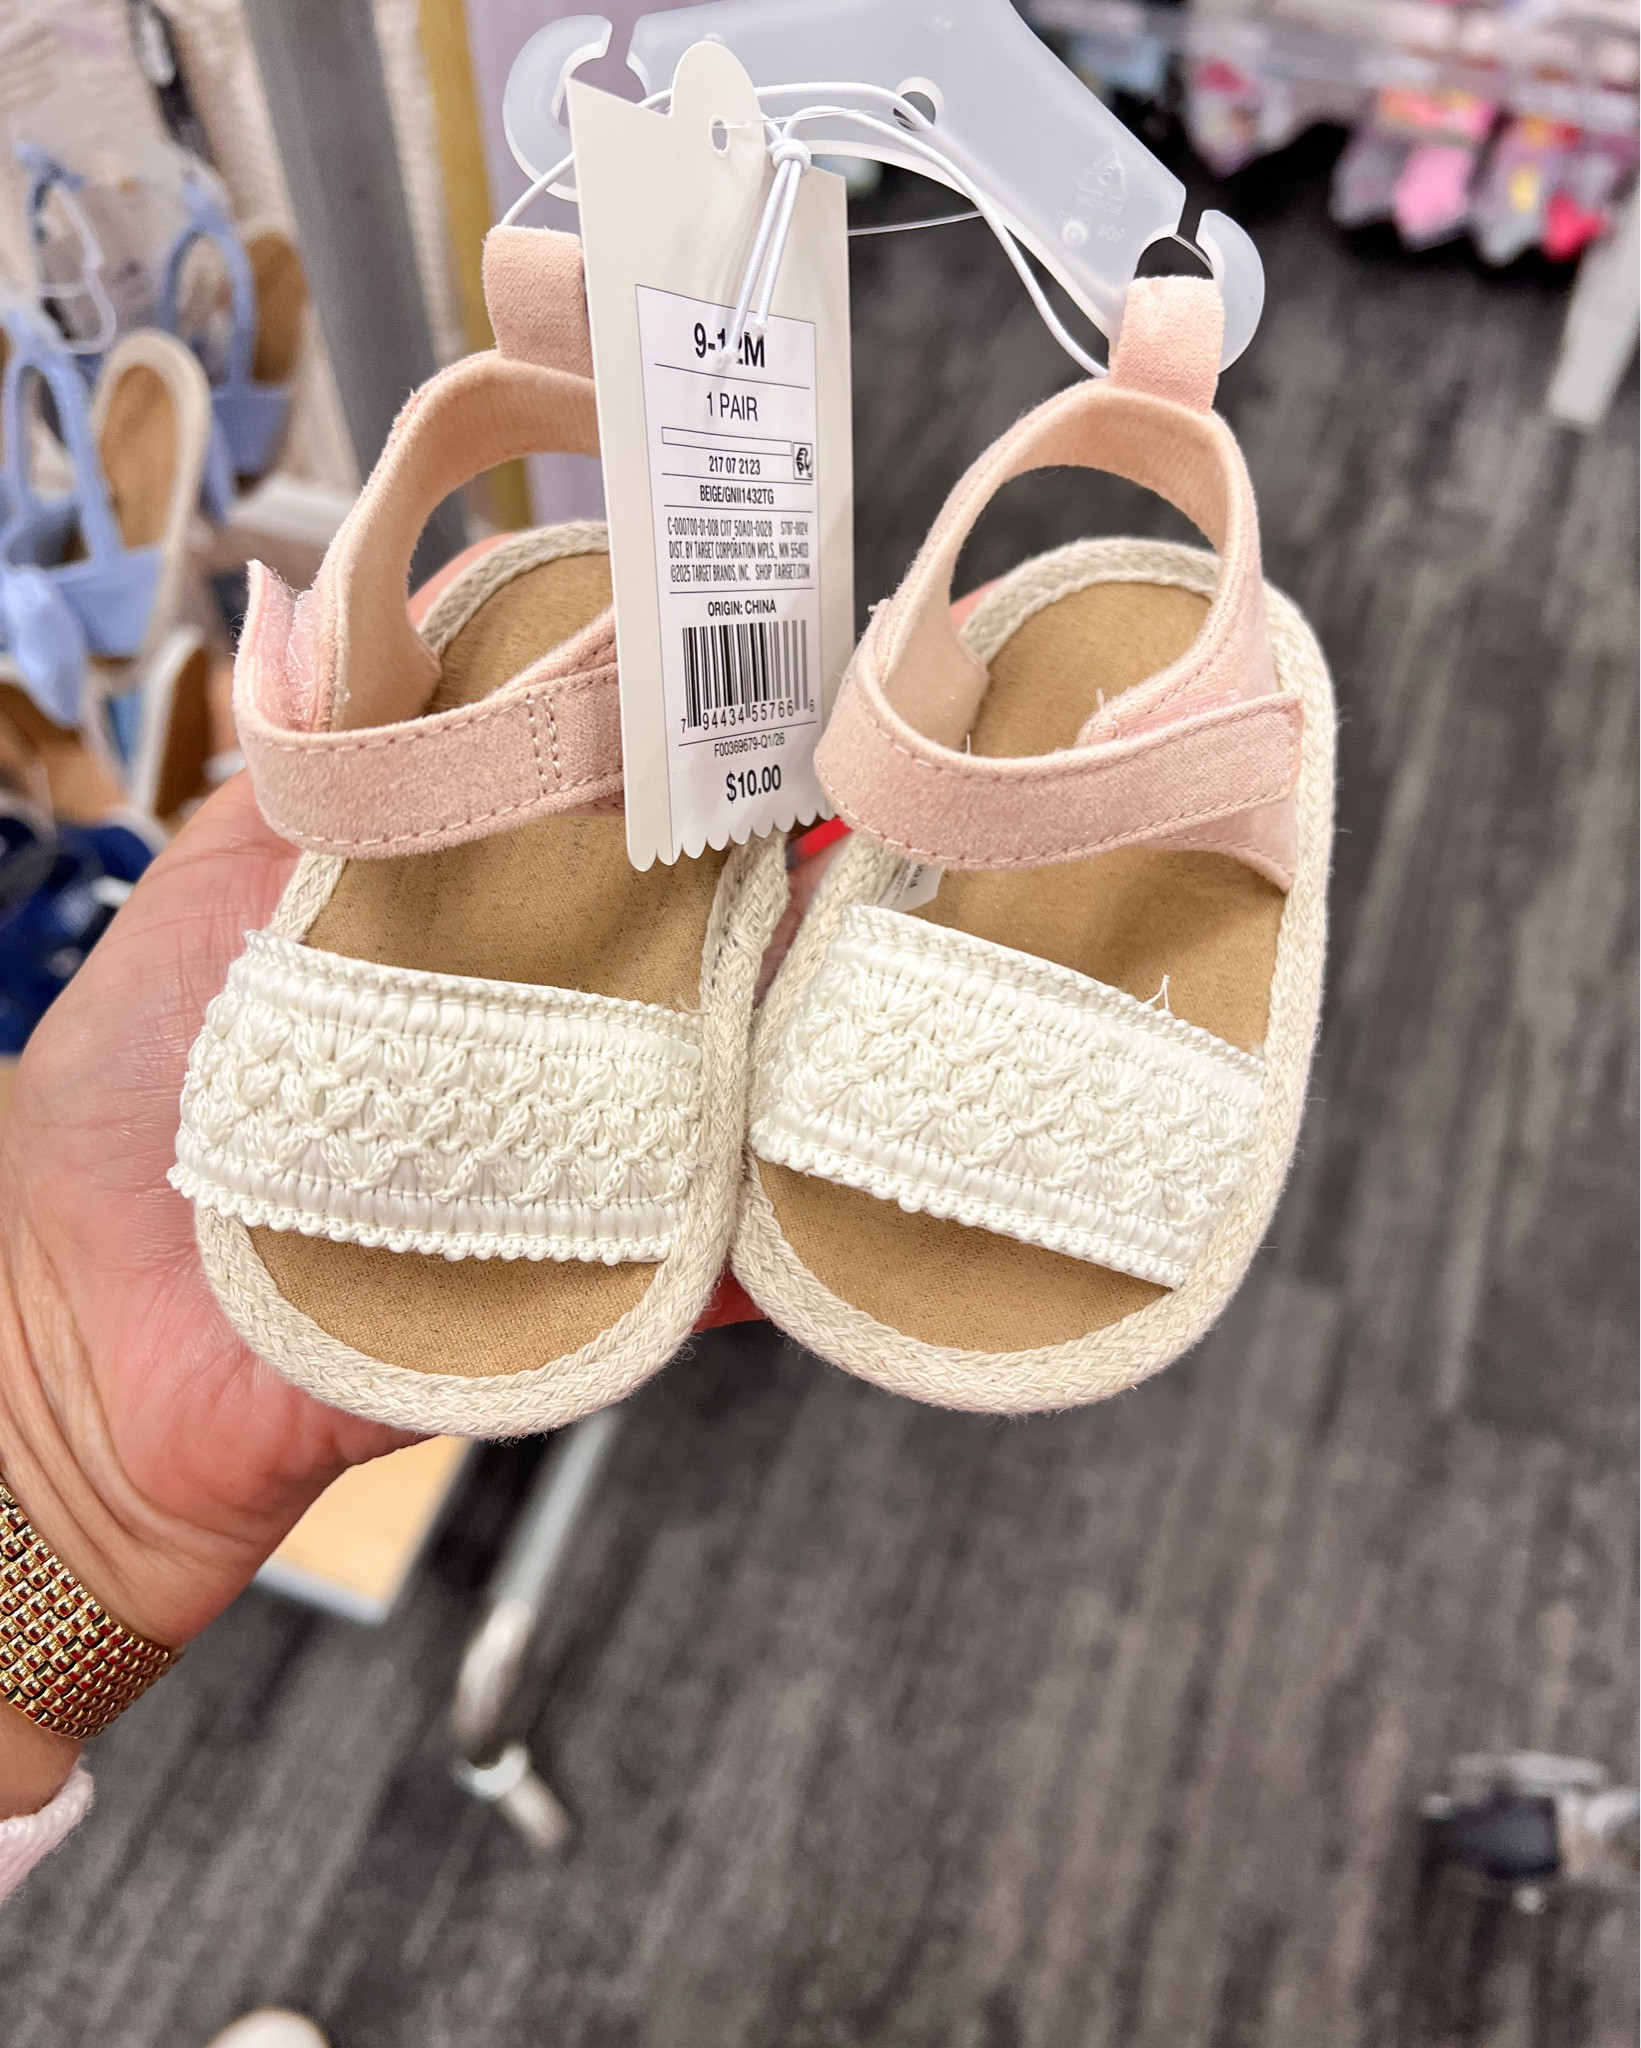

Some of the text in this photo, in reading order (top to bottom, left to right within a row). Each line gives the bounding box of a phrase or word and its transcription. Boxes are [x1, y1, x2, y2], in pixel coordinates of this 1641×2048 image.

[706, 391, 758, 421] 1 PAIR
[709, 455, 761, 475] 217 07 2123
[669, 540, 685, 559] DIST.
[686, 541, 694, 559] BY
[695, 541, 714, 559] TARGET
[715, 542, 756, 559] CORPORATION
[779, 542, 789, 559] MN
[670, 563, 810, 582] ©2025 TARGET BRANDS, INC. SHOP TARGET.COM
[708, 599, 777, 617] ORIGIN: CHINA
[681, 699, 815, 733] 7 94434 55766 6
[714, 732, 785, 758] F00369679-Q1/26
[726, 764, 782, 804] $10.00
